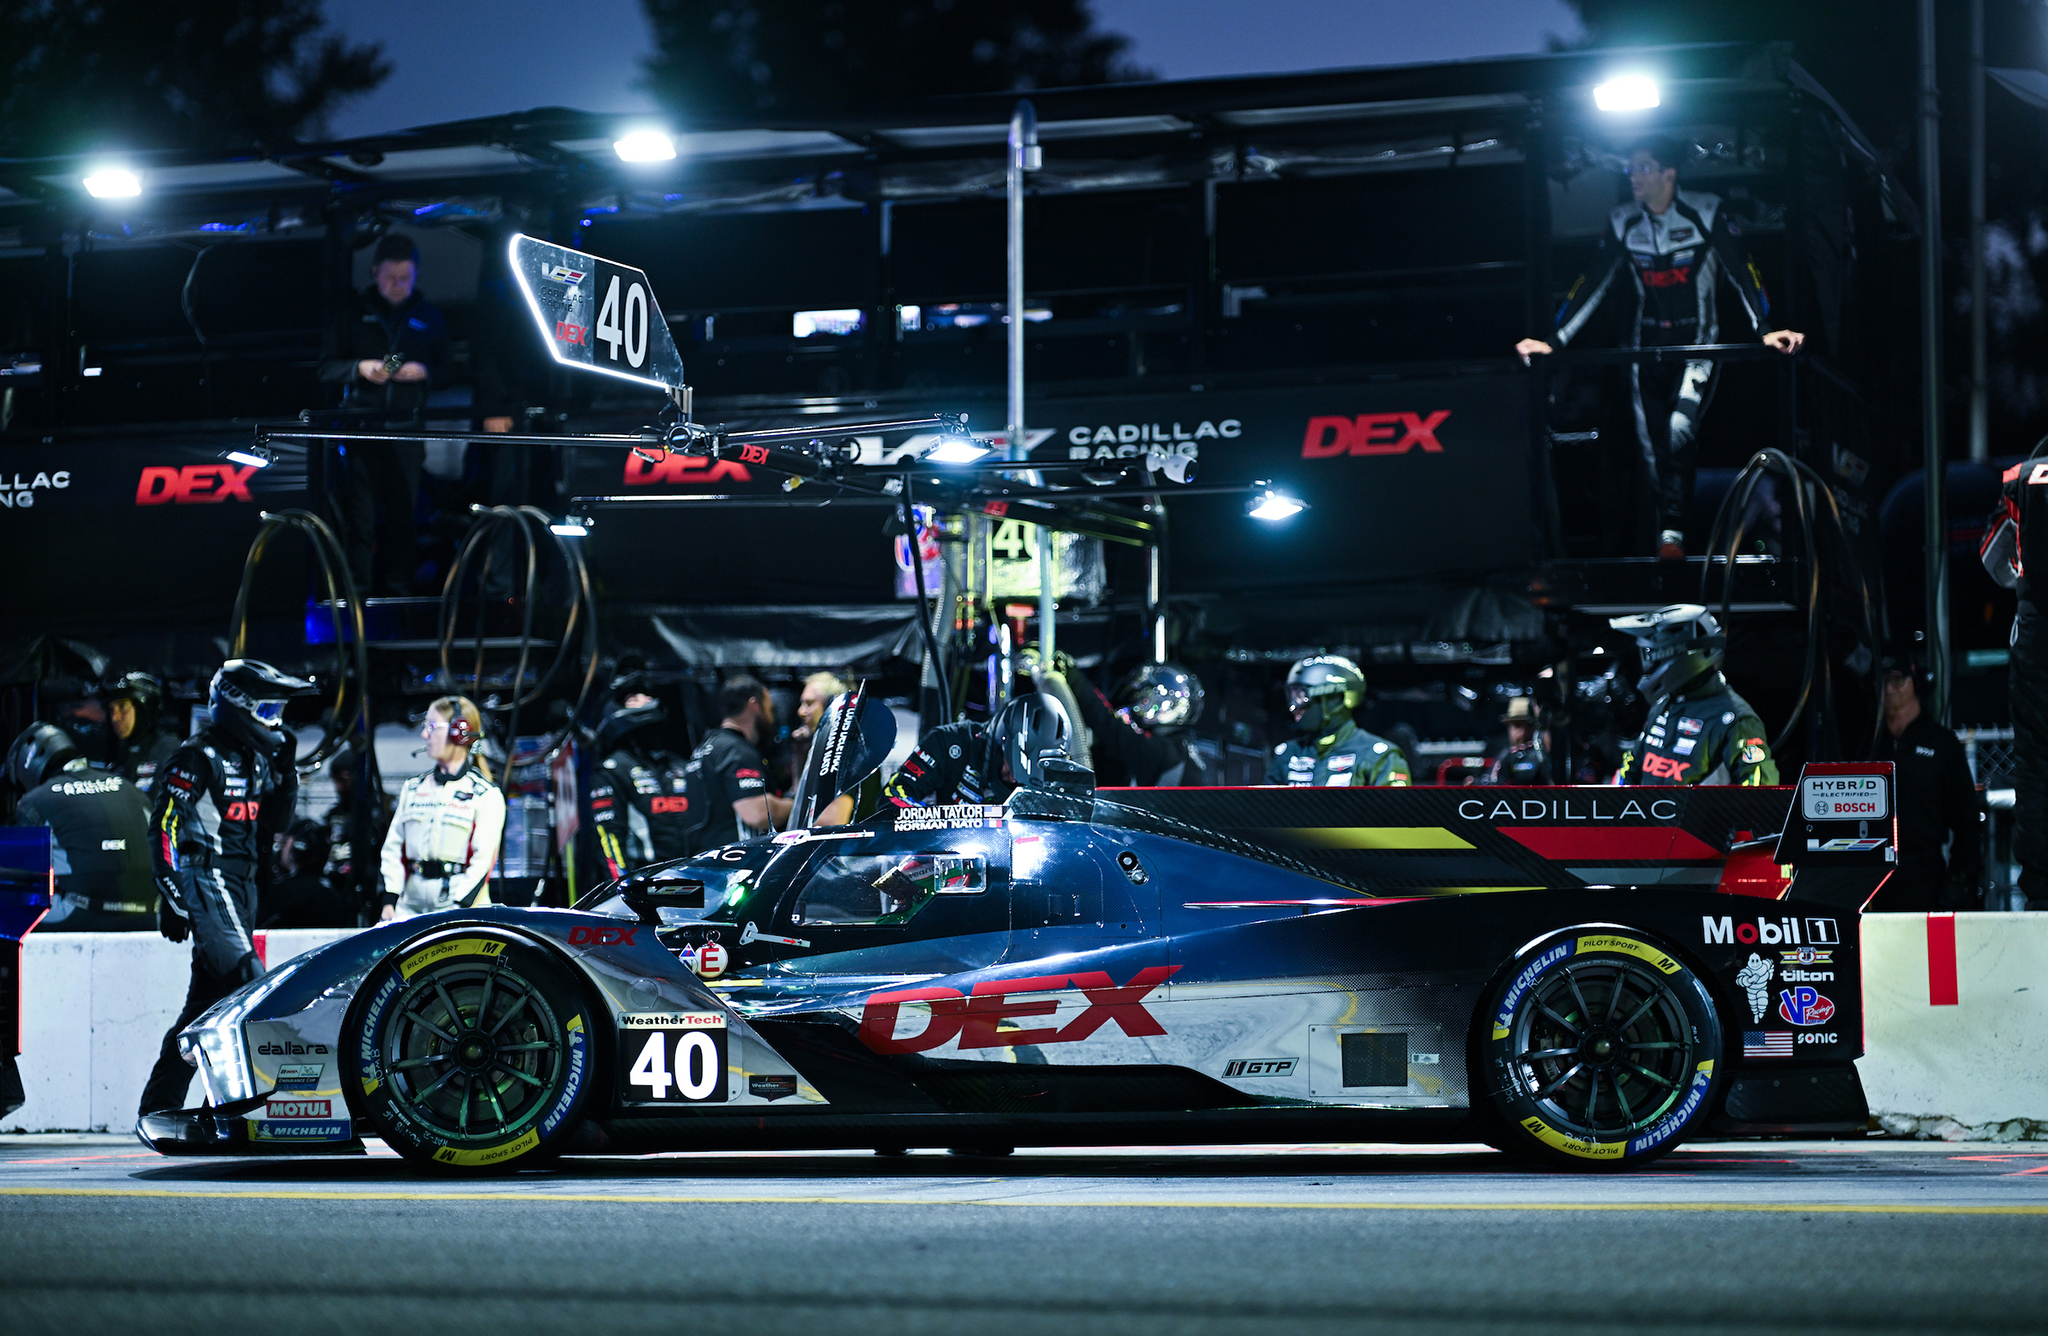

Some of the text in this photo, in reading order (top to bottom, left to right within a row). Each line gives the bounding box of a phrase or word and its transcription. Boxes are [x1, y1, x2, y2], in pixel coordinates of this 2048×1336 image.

[555, 321, 587, 346] DEX
[596, 274, 649, 369] 40
[1069, 419, 1242, 446] CADILLAC
[1302, 410, 1452, 459] DEX
[739, 443, 769, 465] DEX
[136, 464, 258, 506] DEX
[1642, 752, 1691, 781] DEX
[1813, 781, 1876, 789] HYBRID
[896, 806, 983, 820] JORDAN TAYLOR
[1458, 799, 1677, 820] CADILLAC
[1834, 803, 1875, 813] BOSCH
[894, 820, 948, 832] NORMAN
[952, 819, 983, 829] NATO
[568, 926, 641, 946] DEX
[1702, 915, 1801, 945] Mobil
[407, 942, 499, 971] PILOT SPORT M
[495, 953, 517, 970] FL
[701, 948, 720, 972] E
[1610, 940, 1639, 951] SPORT
[1657, 955, 1674, 972] M
[1503, 944, 1568, 1008] MICHELIN
[1527, 975, 1545, 990] RL
[1780, 971, 1834, 982] tilton
[858, 964, 1183, 1055] DEX
[1780, 986, 1818, 1025] VP
[1806, 1005, 1833, 1020] Racing
[361, 976, 397, 1061] MICHELIN
[622, 1015, 722, 1026] WeatherTech
[258, 1041, 328, 1055] dallara
[629, 1031, 719, 1100] 40
[1246, 1061, 1292, 1074] GTP
[543, 1049, 583, 1132] MICHELIN
[269, 1102, 329, 1117] MOTUL
[1634, 1089, 1702, 1152] MICHELIN
[274, 1126, 341, 1135] MICHELIN
[1526, 1118, 1618, 1154] PILOT SPORT M
[441, 1137, 533, 1162] PILOT SPORT M
